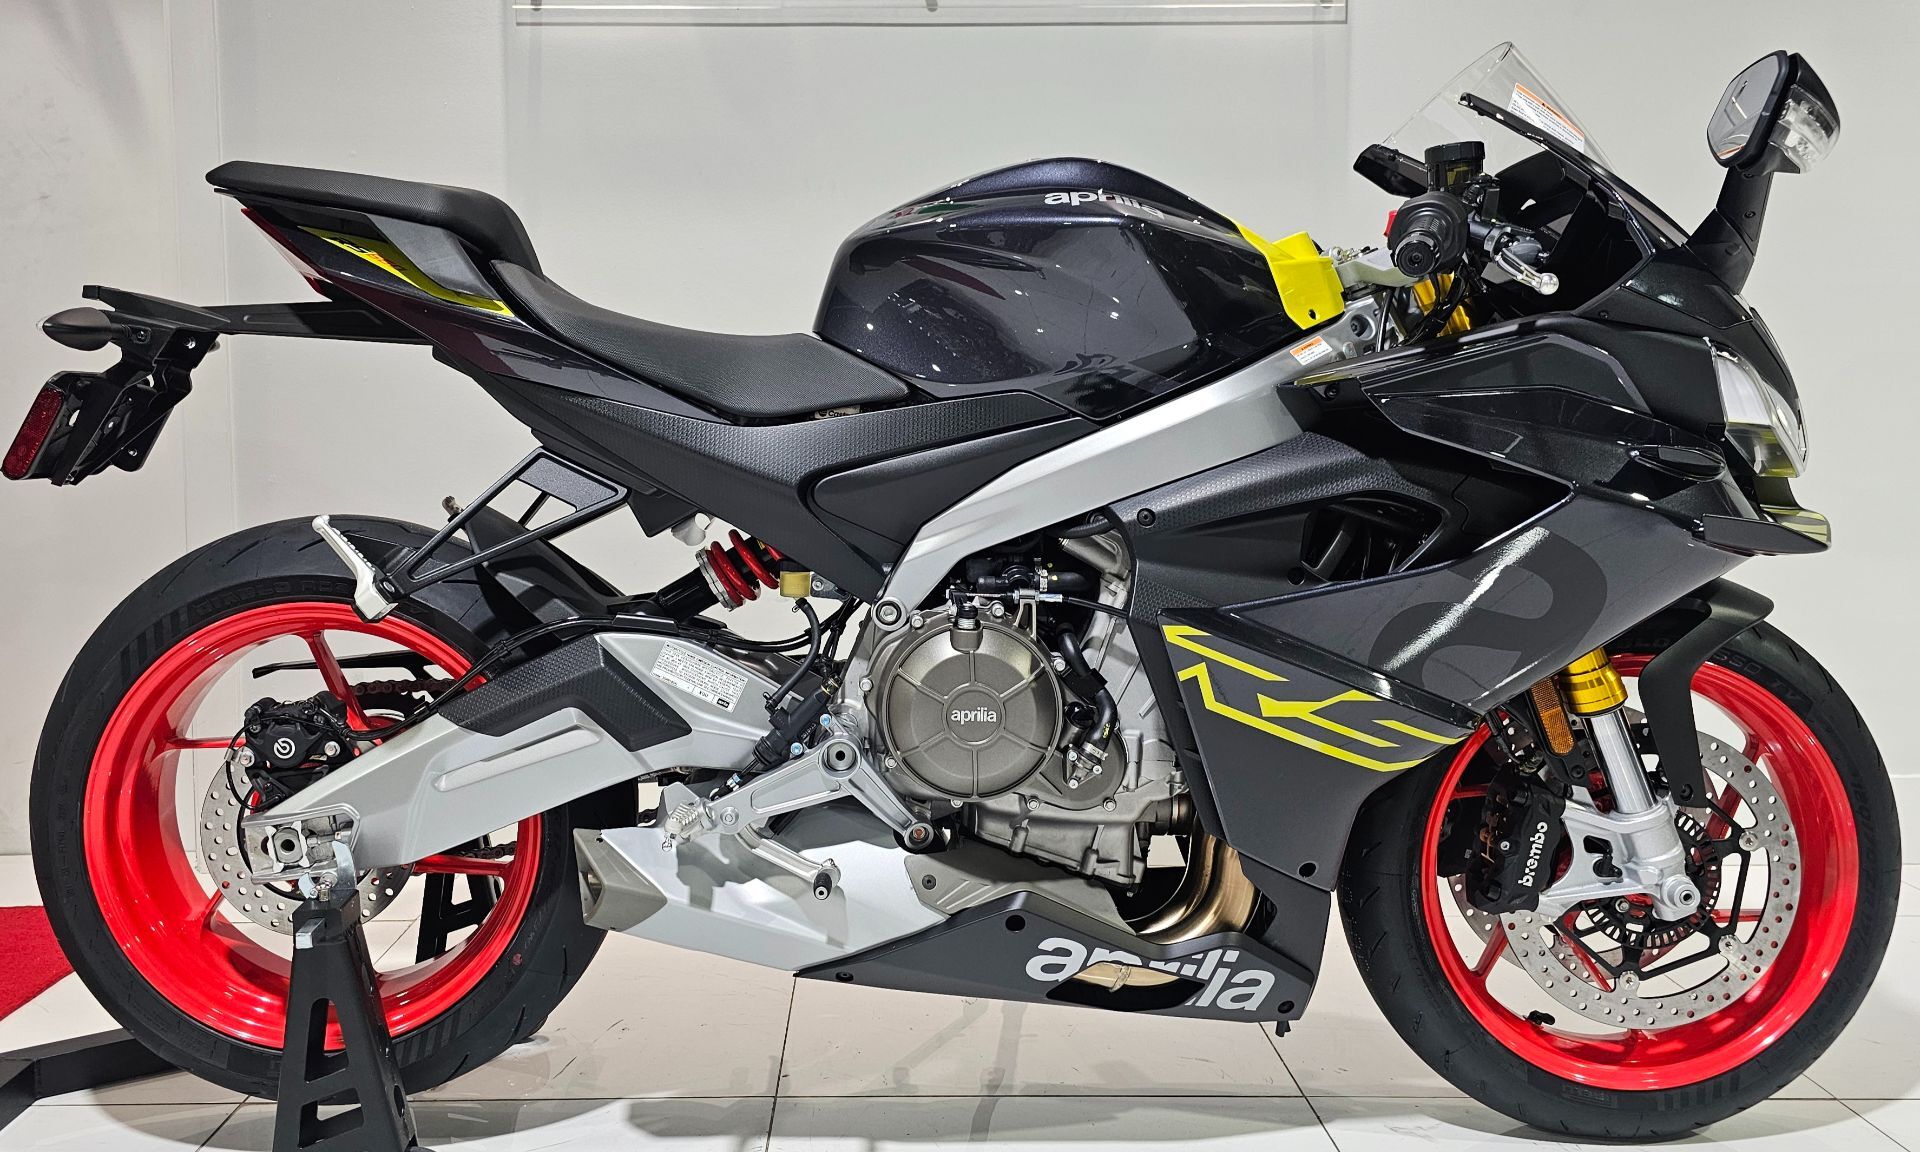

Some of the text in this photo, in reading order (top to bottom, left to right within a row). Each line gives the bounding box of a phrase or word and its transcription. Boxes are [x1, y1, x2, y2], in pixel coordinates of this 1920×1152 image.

[951, 706, 997, 725] aprilia
[1517, 821, 1548, 887] brembo
[1025, 937, 1276, 1011] alia
